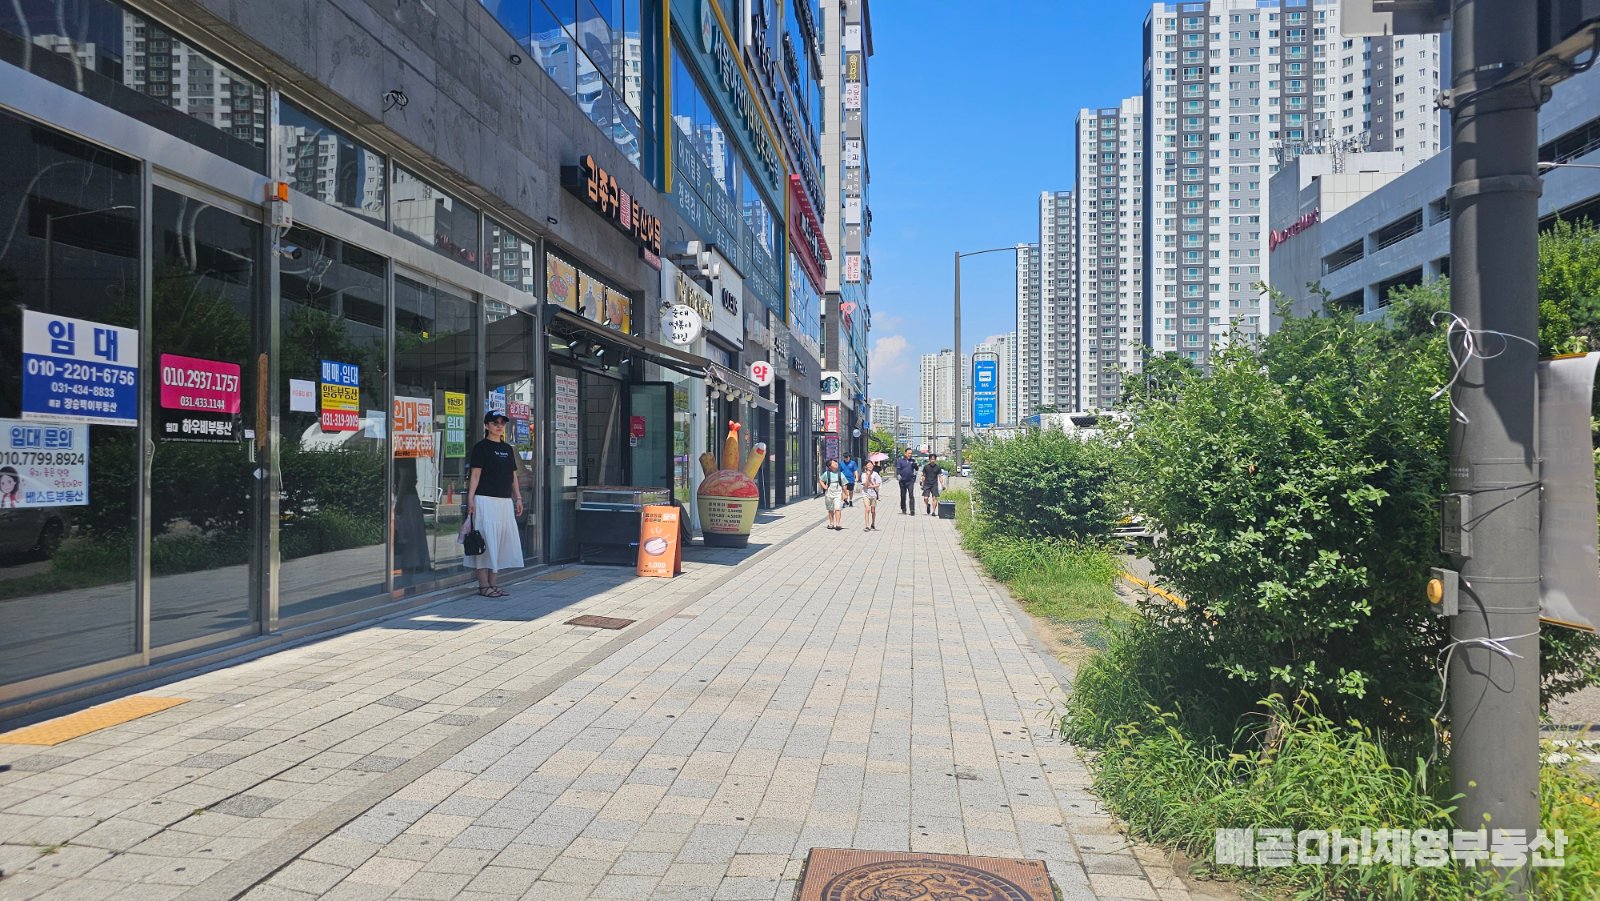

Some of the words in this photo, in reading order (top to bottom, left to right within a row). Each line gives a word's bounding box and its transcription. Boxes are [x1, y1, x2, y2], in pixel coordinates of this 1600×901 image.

[678, 139, 701, 187] 어지럼증
[586, 154, 619, 219] 김종구
[632, 195, 661, 257] 부산어묵
[678, 181, 701, 228] 청력검사
[28, 358, 135, 386] 010-2201-6756
[163, 366, 239, 393] 010.2937.1757
[753, 365, 768, 381] 약
[51, 381, 115, 398] 031-434-8833
[180, 395, 225, 410] 031.433.1144
[394, 399, 418, 432] 임대
[11, 426, 41, 448] 임대
[44, 427, 73, 449] 문의
